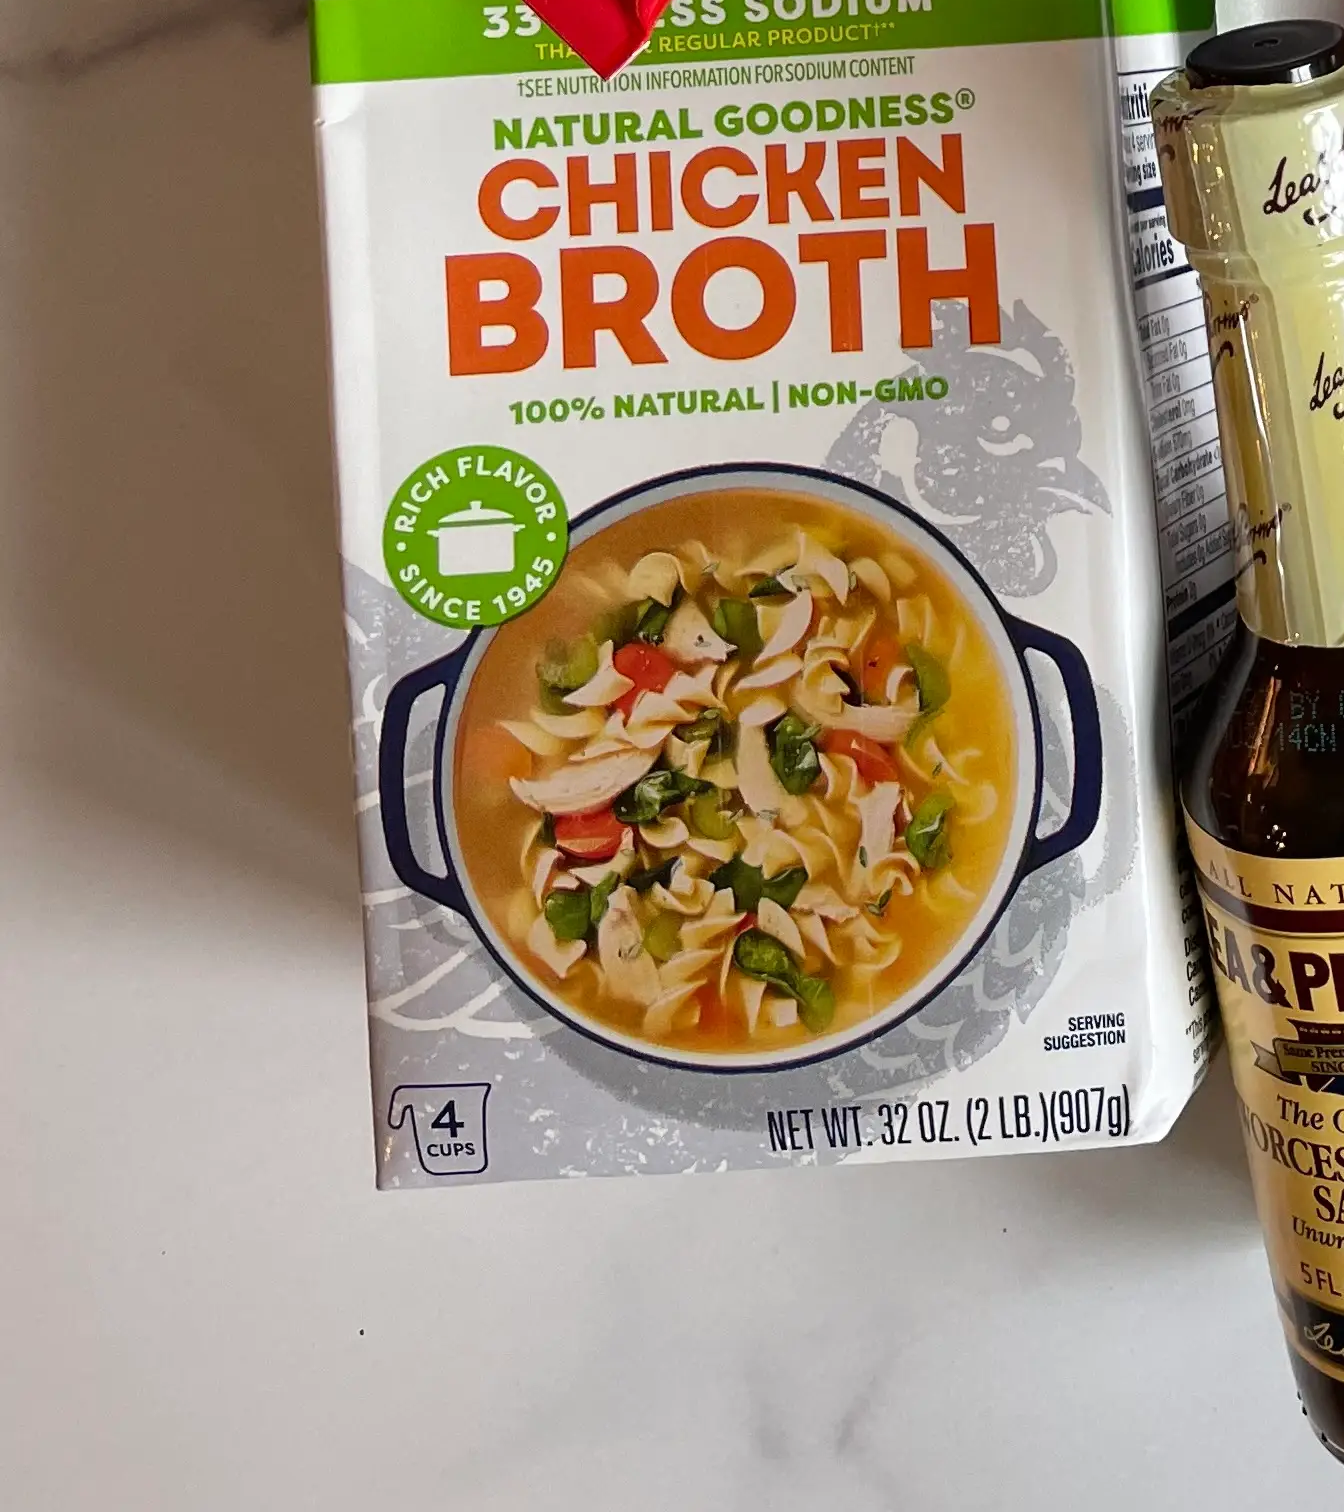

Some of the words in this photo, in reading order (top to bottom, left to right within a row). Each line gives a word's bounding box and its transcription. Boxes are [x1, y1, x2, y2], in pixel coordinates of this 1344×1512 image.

[659, 31, 762, 53] REGULAR
[645, 66, 751, 90] INFORMATION
[755, 64, 783, 84] FOR
[784, 60, 847, 82] SODIUM
[848, 55, 916, 78] CONTENT
[493, 108, 703, 151] NATURAL
[477, 133, 967, 242] CHICKEN
[444, 222, 1000, 377] BROTH
[509, 396, 605, 426] 100%
[613, 386, 764, 420] NATURAL
[788, 375, 949, 409] NON-GMO
[394, 466, 450, 533] RICH
[456, 455, 557, 525] FLAVOR
[399, 563, 481, 621] SINCE
[491, 555, 554, 615] 1945
[1209, 859, 1252, 898] ALL
[1042, 1029, 1127, 1052] SUGGESTION
[1067, 1012, 1126, 1031] SERVING
[430, 1099, 465, 1137] 4
[766, 1107, 814, 1152] NET
[824, 1104, 873, 1148] WT.
[877, 1099, 915, 1147] 32
[922, 1099, 960, 1143] OZ.
[965, 1096, 992, 1145] (2
[1277, 1093, 1324, 1130] The
[425, 1139, 477, 1159] CUPS
[1316, 1272, 1342, 1297] FL
